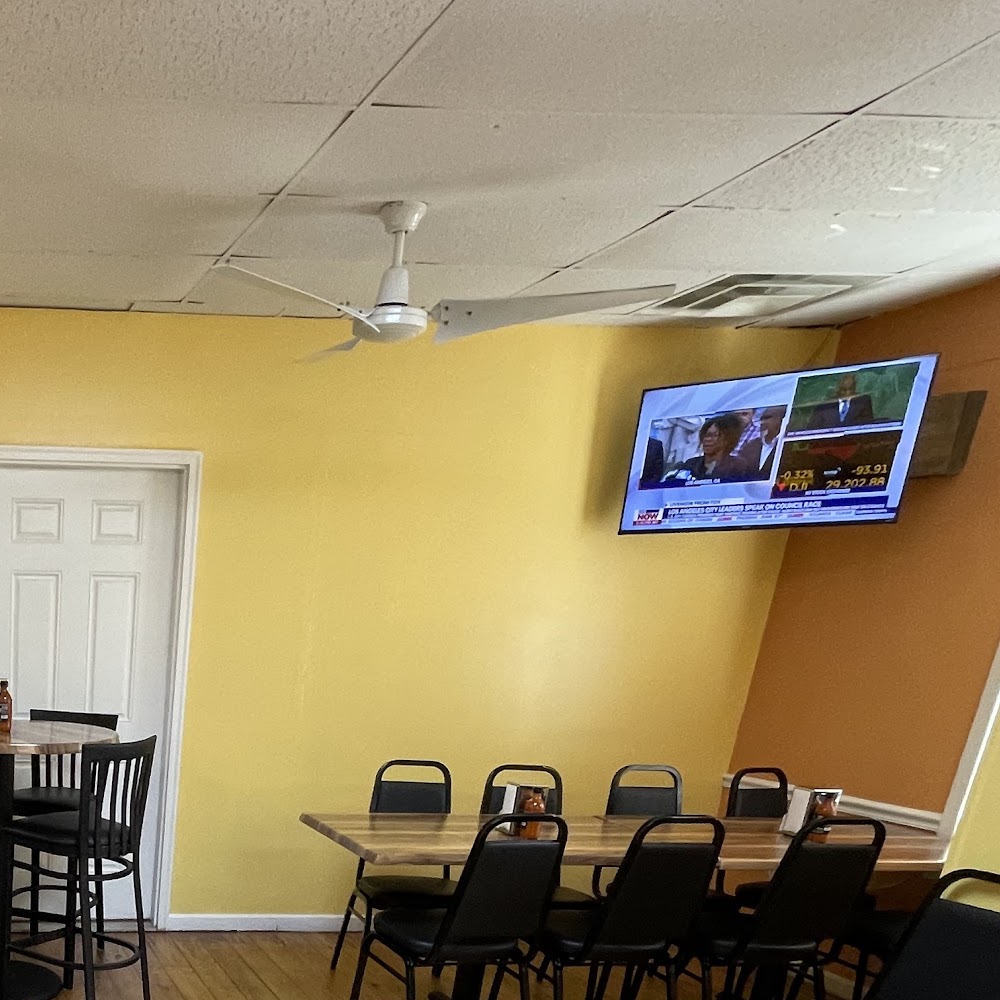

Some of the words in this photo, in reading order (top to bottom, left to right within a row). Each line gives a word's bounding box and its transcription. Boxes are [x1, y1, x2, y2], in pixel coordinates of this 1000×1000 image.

[780, 469, 815, 480] -0.32%
[851, 464, 888, 475] -93.91
[825, 477, 885, 489] 2920288
[719, 504, 744, 513] LEADERS
[745, 503, 765, 511] SPEAK
[775, 501, 803, 509] COUNCIL
[803, 500, 822, 508] RACE
[637, 512, 659, 520] NOW
